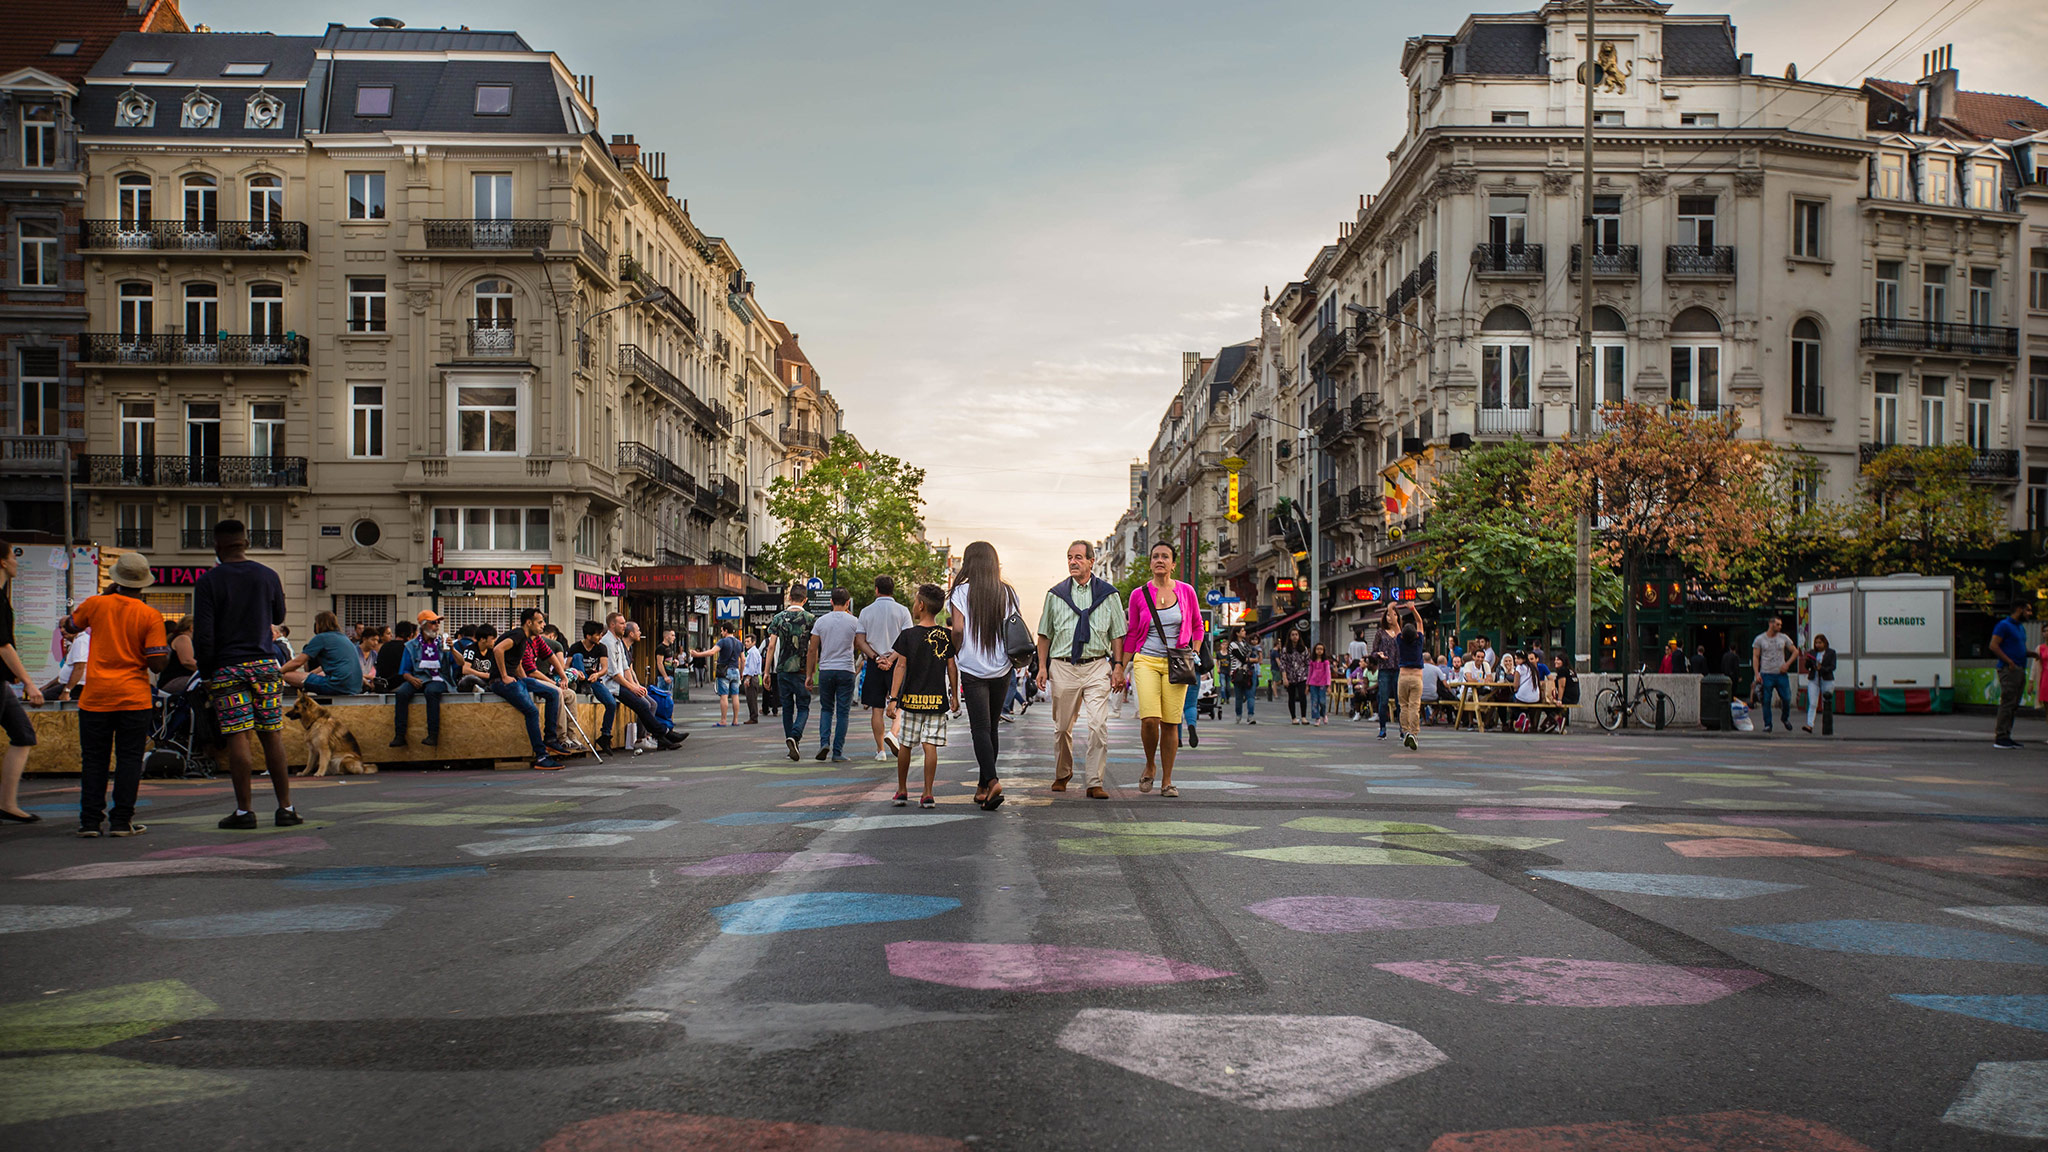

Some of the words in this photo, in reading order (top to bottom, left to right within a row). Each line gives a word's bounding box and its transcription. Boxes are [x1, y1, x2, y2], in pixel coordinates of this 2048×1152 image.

[149, 567, 165, 584] CI
[171, 567, 210, 584] PAR
[464, 569, 516, 586] PARIS
[522, 569, 546, 586] XL
[609, 575, 621, 583] ICI
[605, 582, 626, 590] PARIS
[717, 599, 740, 618] M
[1877, 616, 1926, 626] ESCARGOTS
[901, 693, 943, 705] AFRIQUE
